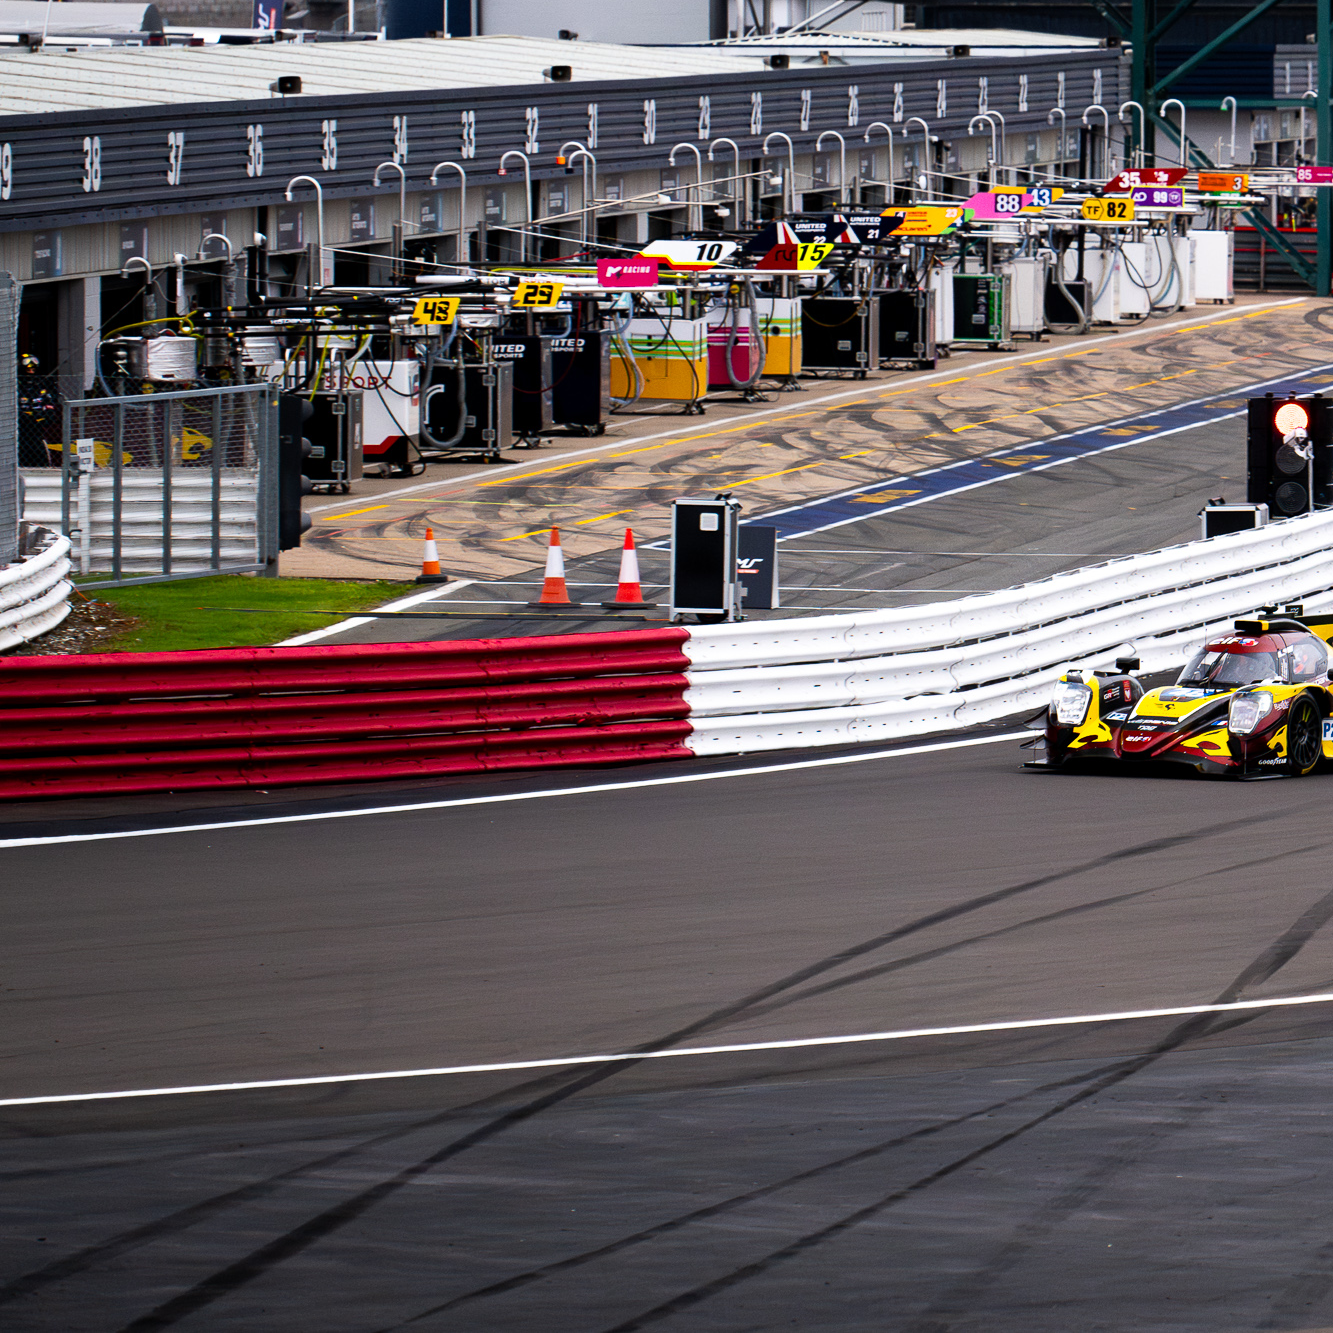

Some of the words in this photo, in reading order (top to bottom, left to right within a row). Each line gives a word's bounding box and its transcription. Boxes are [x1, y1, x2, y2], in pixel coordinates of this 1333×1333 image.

[643, 99, 656, 145] 30
[751, 92, 762, 135] 28
[800, 89, 811, 131] 27
[393, 115, 409, 165] 34
[461, 110, 476, 159] 33
[525, 107, 539, 154] 32
[587, 103, 598, 149] 31
[167, 131, 184, 185] 37
[246, 124, 263, 177] 36
[321, 119, 337, 171] 35
[0, 142, 12, 200] 9
[83, 136, 101, 193] 38
[1119, 172, 1141, 188] 35
[1298, 169, 1312, 181] 85
[1031, 188, 1050, 206] 43
[1153, 191, 1168, 203] 99
[1232, 177, 1242, 191] 3
[996, 194, 1020, 212] 88
[1086, 205, 1100, 215] TF
[1107, 202, 1127, 218] 82
[867, 229, 880, 239] 21
[697, 243, 723, 261] 10
[799, 244, 827, 262] 15
[523, 285, 554, 305] 29
[1258, 757, 1287, 765] GOODYEAR
